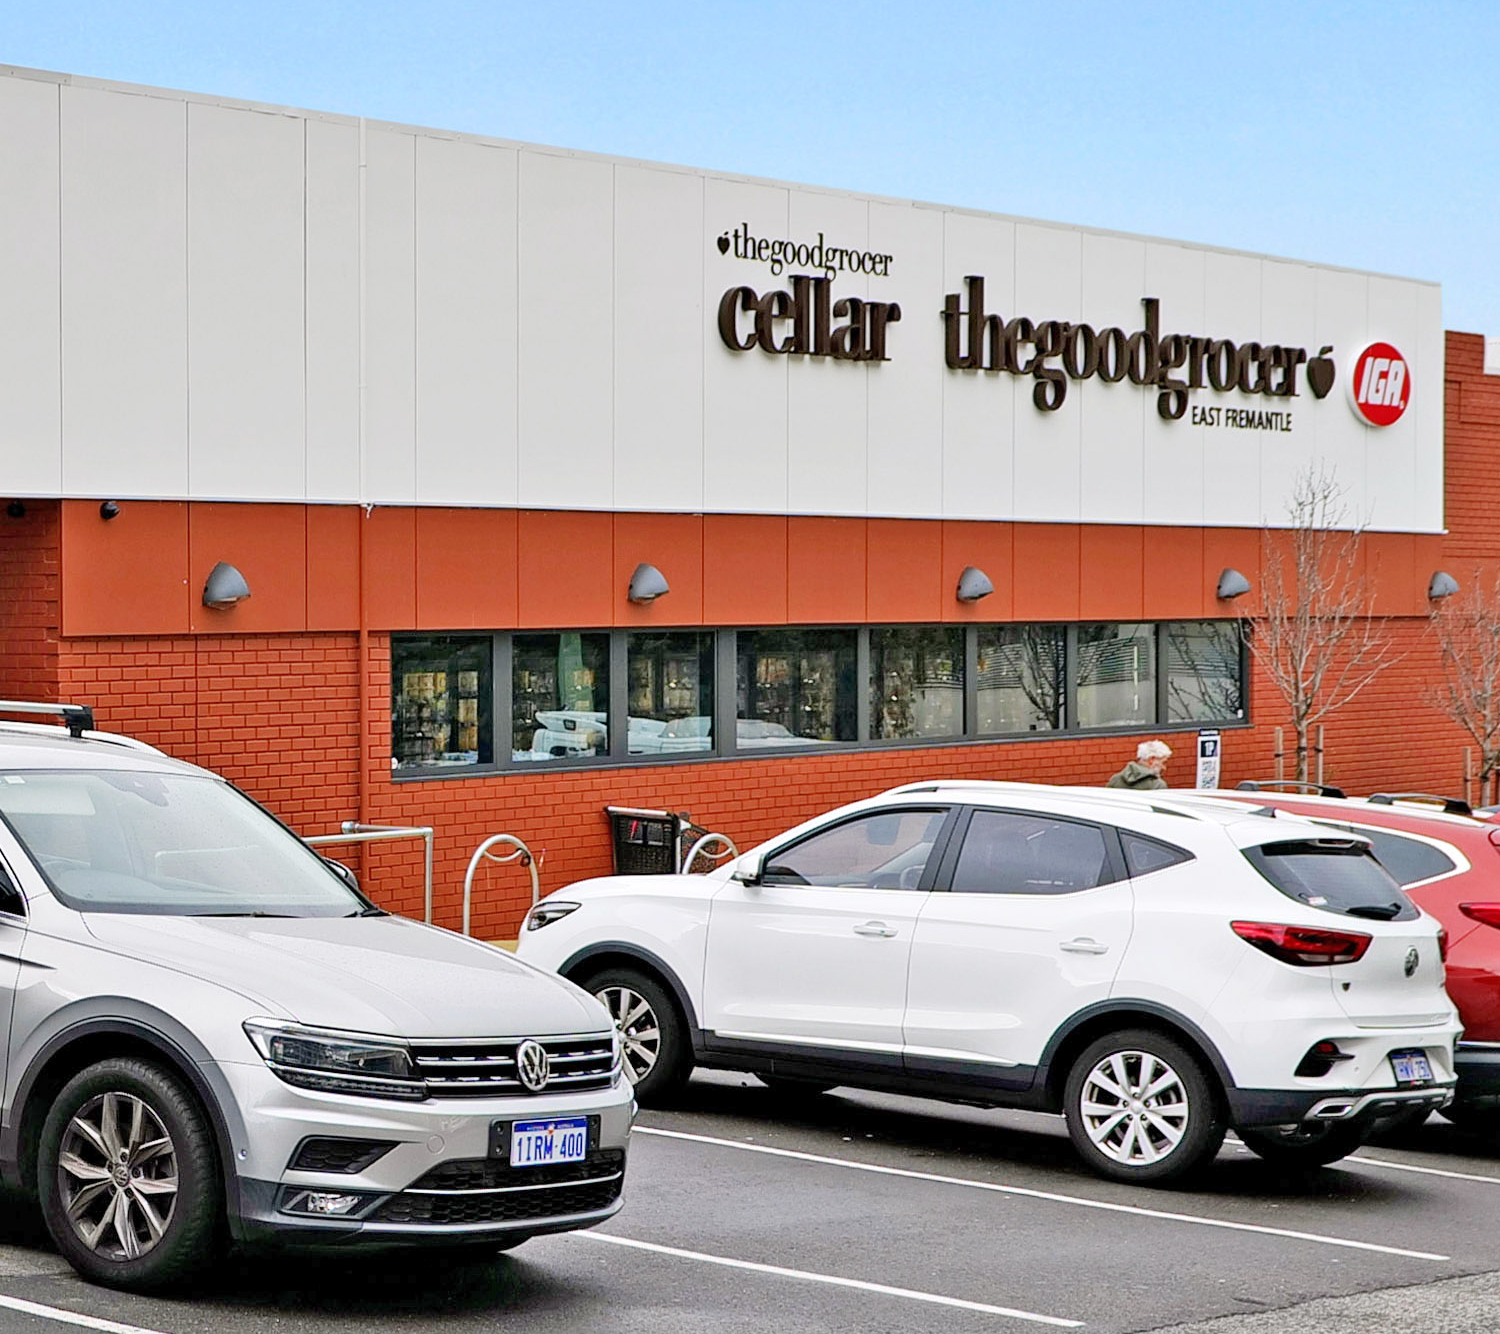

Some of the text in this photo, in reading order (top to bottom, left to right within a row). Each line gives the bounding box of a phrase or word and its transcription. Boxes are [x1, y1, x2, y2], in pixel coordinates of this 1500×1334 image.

[732, 222, 893, 282] thegoodgrocer
[717, 274, 902, 362] cellar
[940, 275, 1307, 421] thegoodgrocer
[1357, 356, 1403, 408] IGA
[1191, 406, 1293, 433] EAST FREMANTLE
